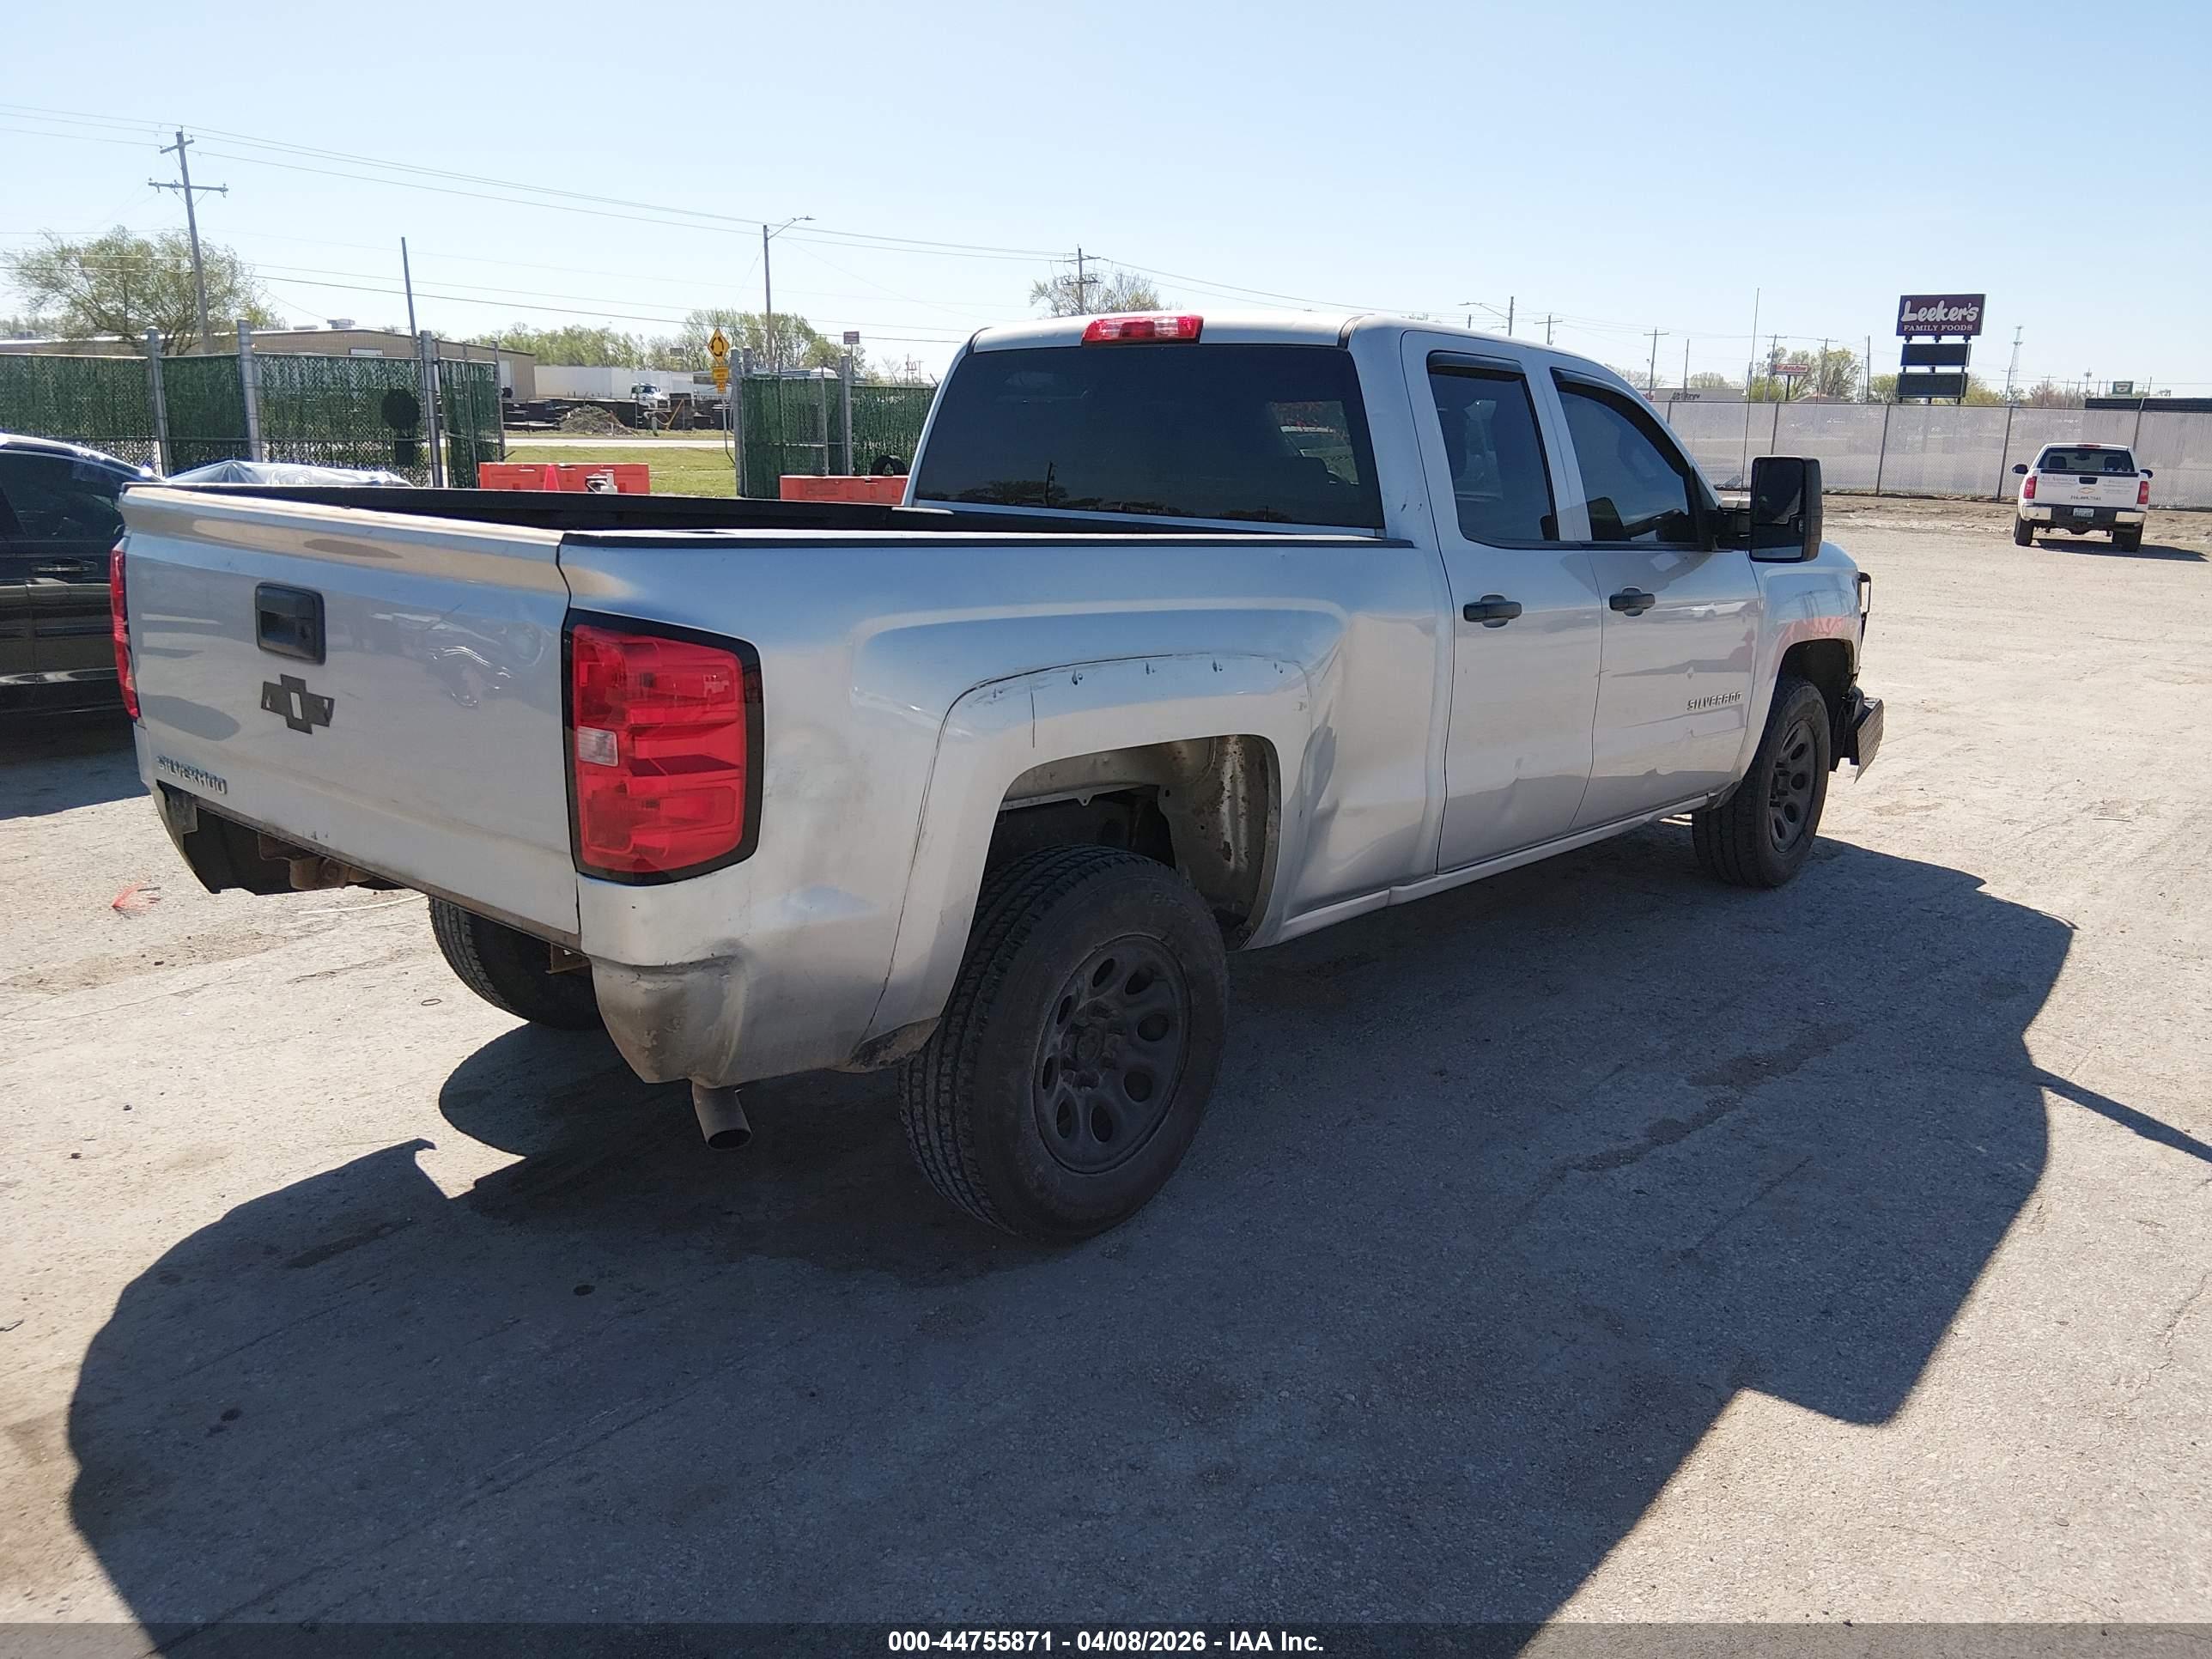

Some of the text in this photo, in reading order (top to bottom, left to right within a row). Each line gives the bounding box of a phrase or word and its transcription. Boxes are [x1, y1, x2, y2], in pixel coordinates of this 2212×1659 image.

[1900, 300, 1979, 322] Leeker's
[1686, 690, 1742, 711] SILVERADO
[157, 756, 228, 794] SILVERADO
